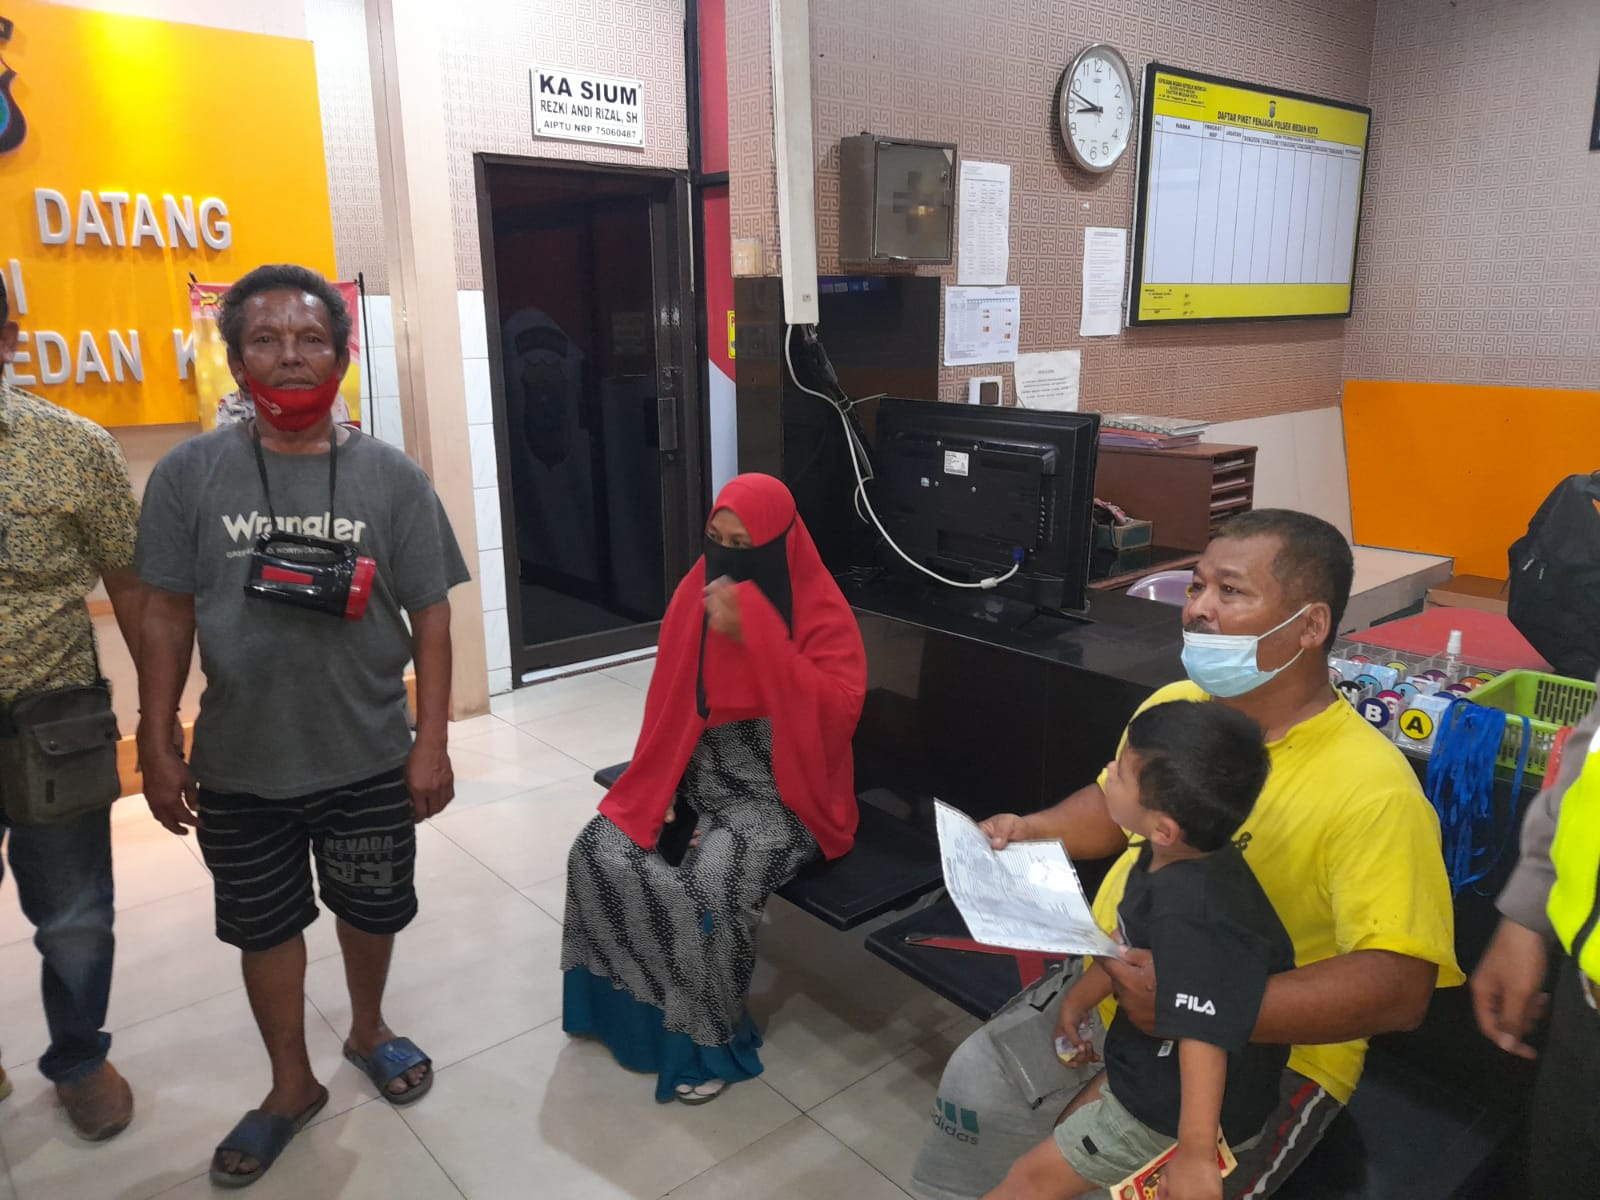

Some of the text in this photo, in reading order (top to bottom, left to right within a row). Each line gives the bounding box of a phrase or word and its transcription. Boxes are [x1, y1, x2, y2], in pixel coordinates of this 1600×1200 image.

[540, 74, 637, 106] KA SIUM
[540, 99, 568, 115] REZKI
[571, 103, 593, 118] ANDI
[626, 111, 638, 124] SH
[1217, 110, 1318, 135] DAFTAR PIKET PENJAGA POLSEK MEDAN KOTA
[543, 120, 637, 139] AIPTU NRP 75060487
[34, 187, 233, 250] DATANG
[221, 510, 366, 543] Wrangler
[1364, 703, 1382, 722] B
[1406, 715, 1424, 735] A
[323, 835, 393, 851] NEVADA
[1175, 992, 1216, 1016] FILA
